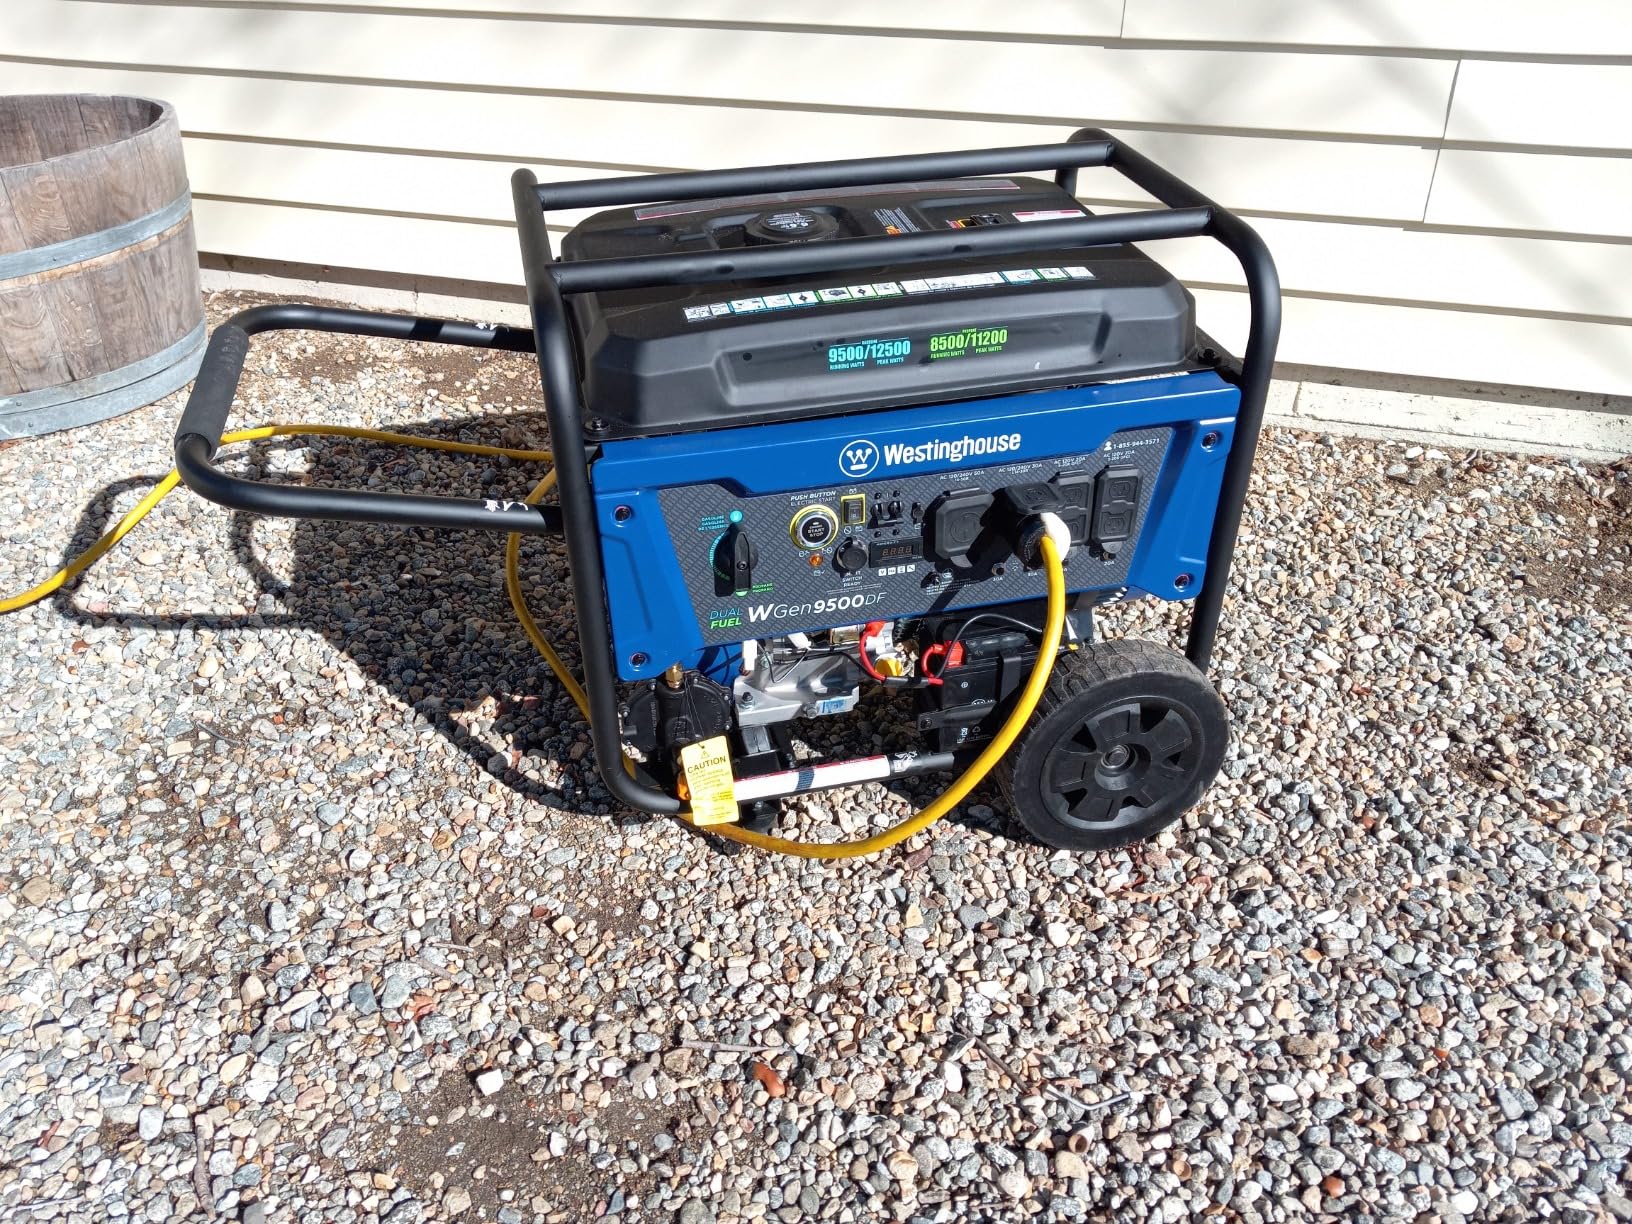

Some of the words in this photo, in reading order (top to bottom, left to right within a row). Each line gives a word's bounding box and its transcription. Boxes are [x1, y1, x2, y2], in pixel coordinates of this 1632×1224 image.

[930, 329, 1008, 352] 8500/11200
[828, 340, 911, 363] 9500/12500
[883, 433, 1022, 467] Westinghouse
[809, 490, 837, 499] BUTTON
[842, 575, 863, 583] SWITCH
[709, 608, 743, 620] DUAL
[710, 617, 742, 630] FUEL
[688, 756, 726, 773] CAUTION
